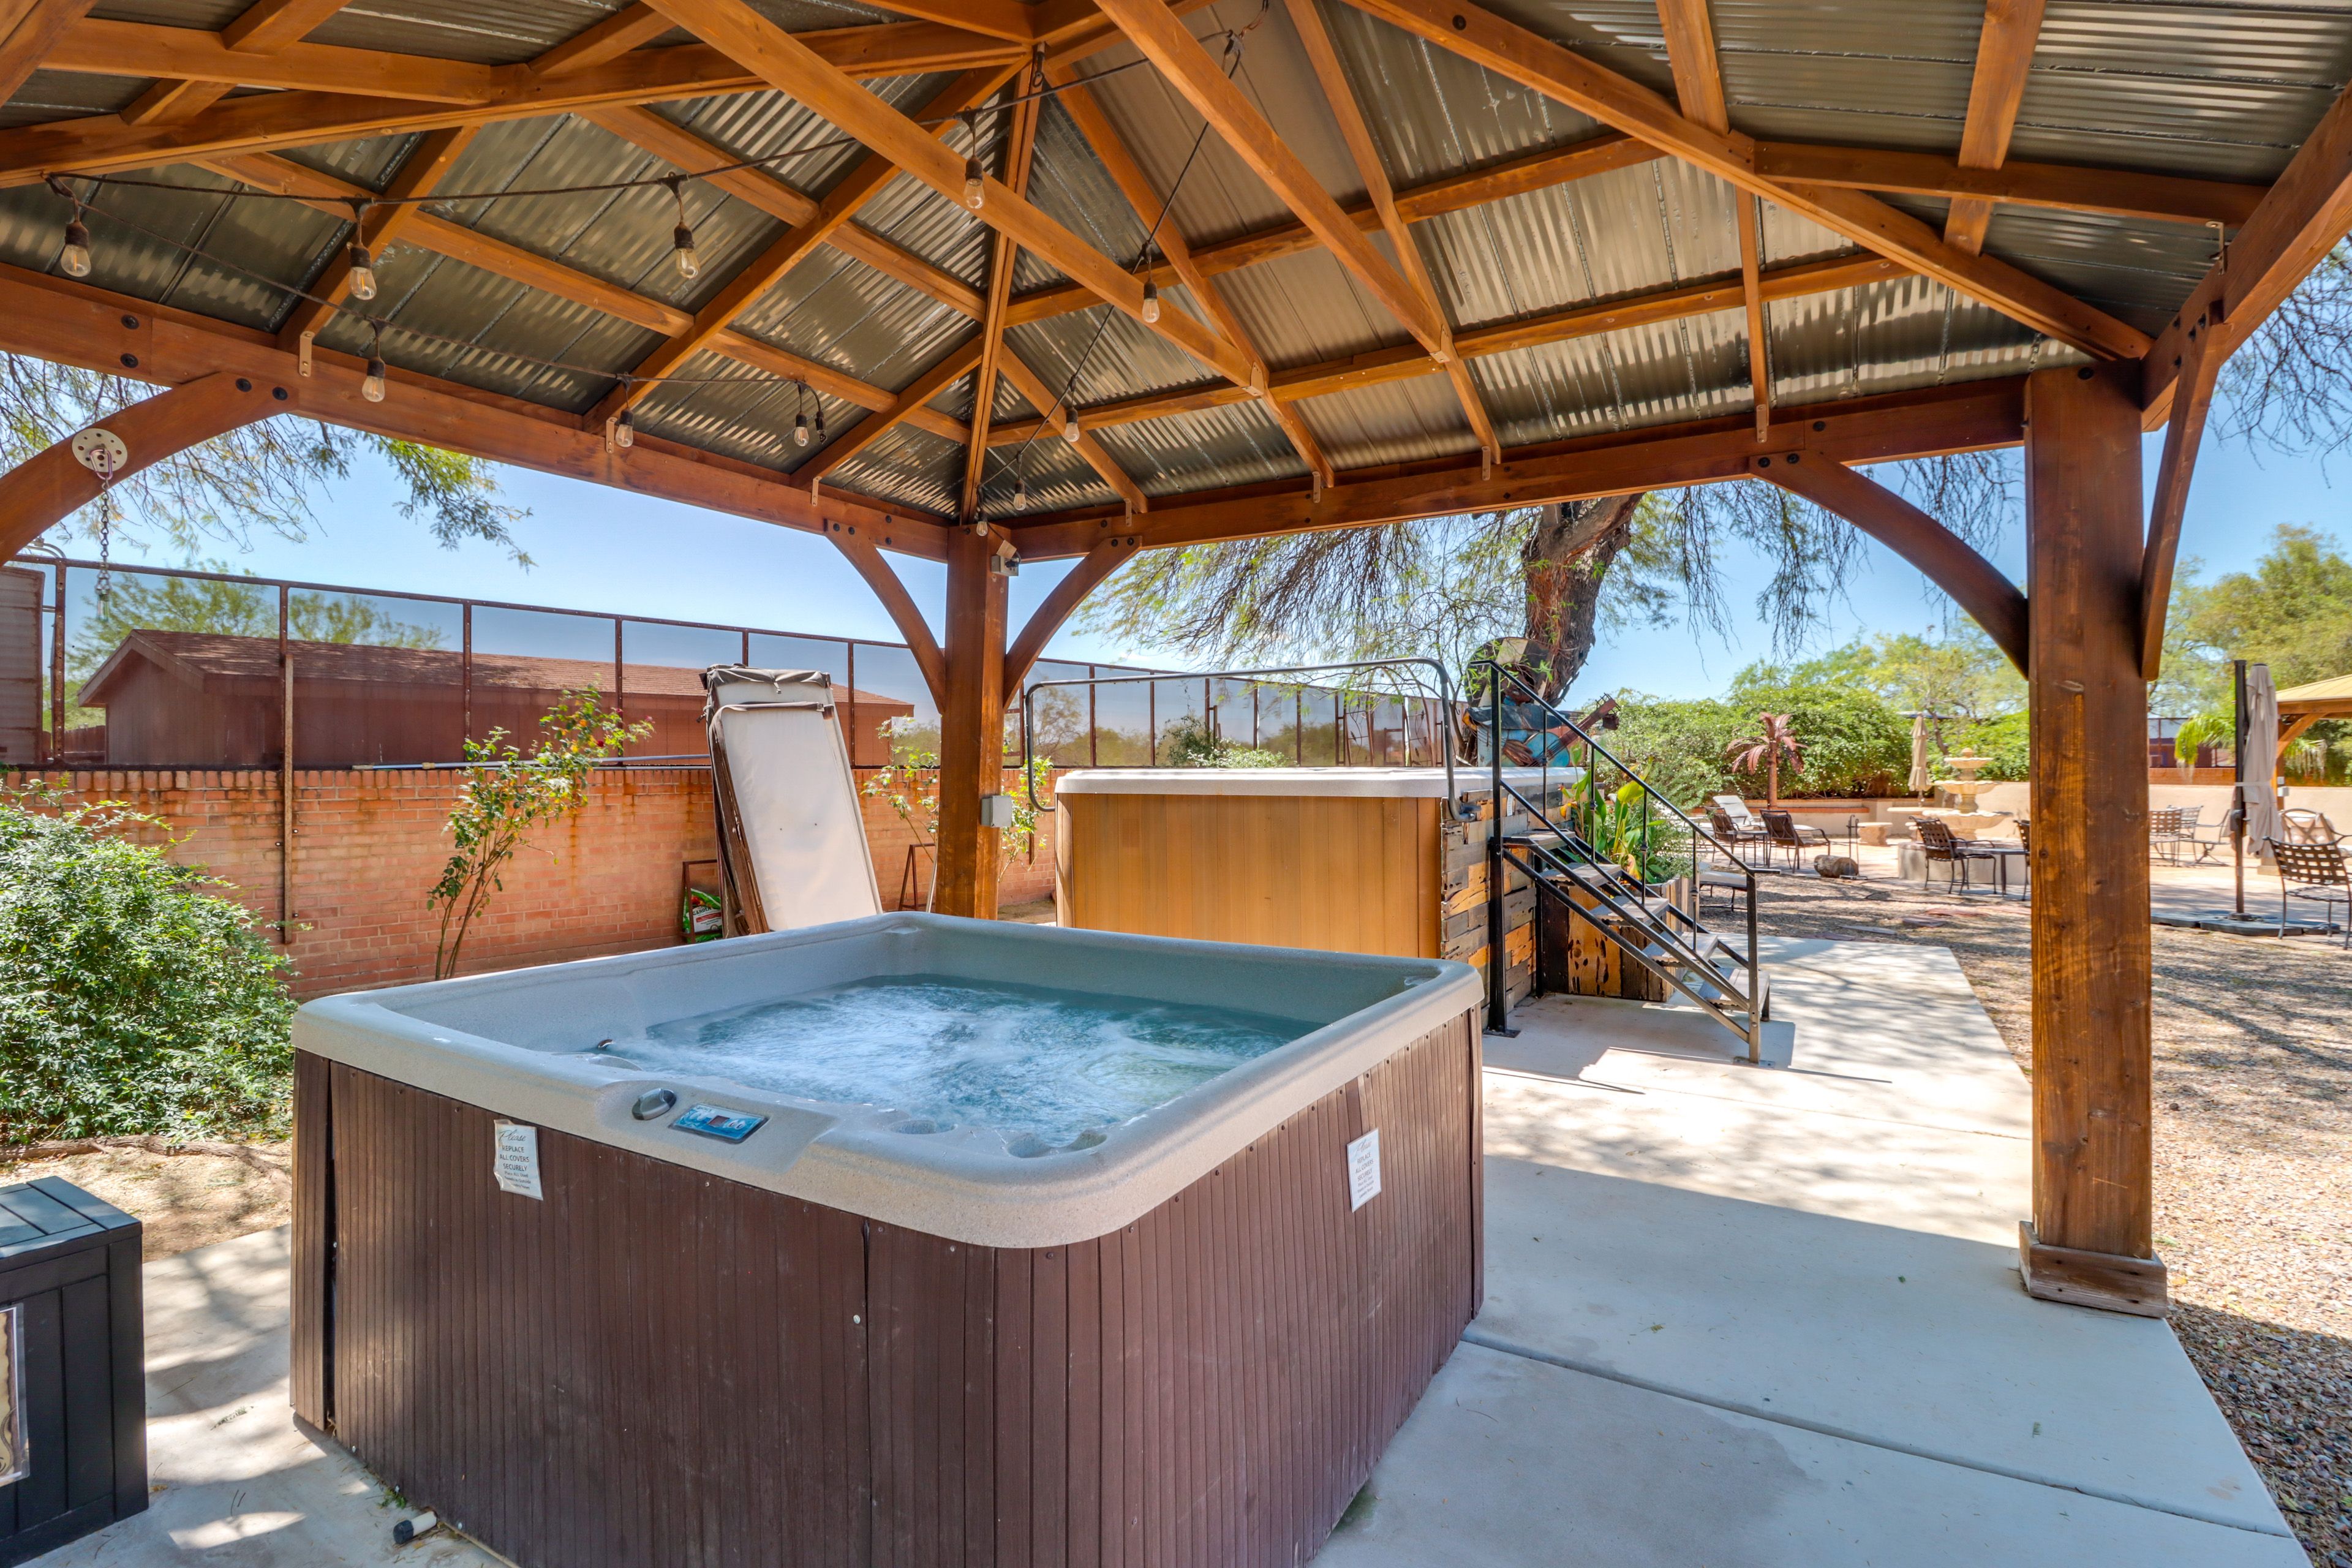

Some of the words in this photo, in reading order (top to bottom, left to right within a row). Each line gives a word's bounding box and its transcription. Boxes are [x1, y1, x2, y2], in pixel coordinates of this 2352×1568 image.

[499, 1129, 526, 1142] Please
[1357, 1152, 1371, 1164] REPLACE
[1361, 1159, 1374, 1170] COVERS
[1357, 1167, 1373, 1182] SECURELY
